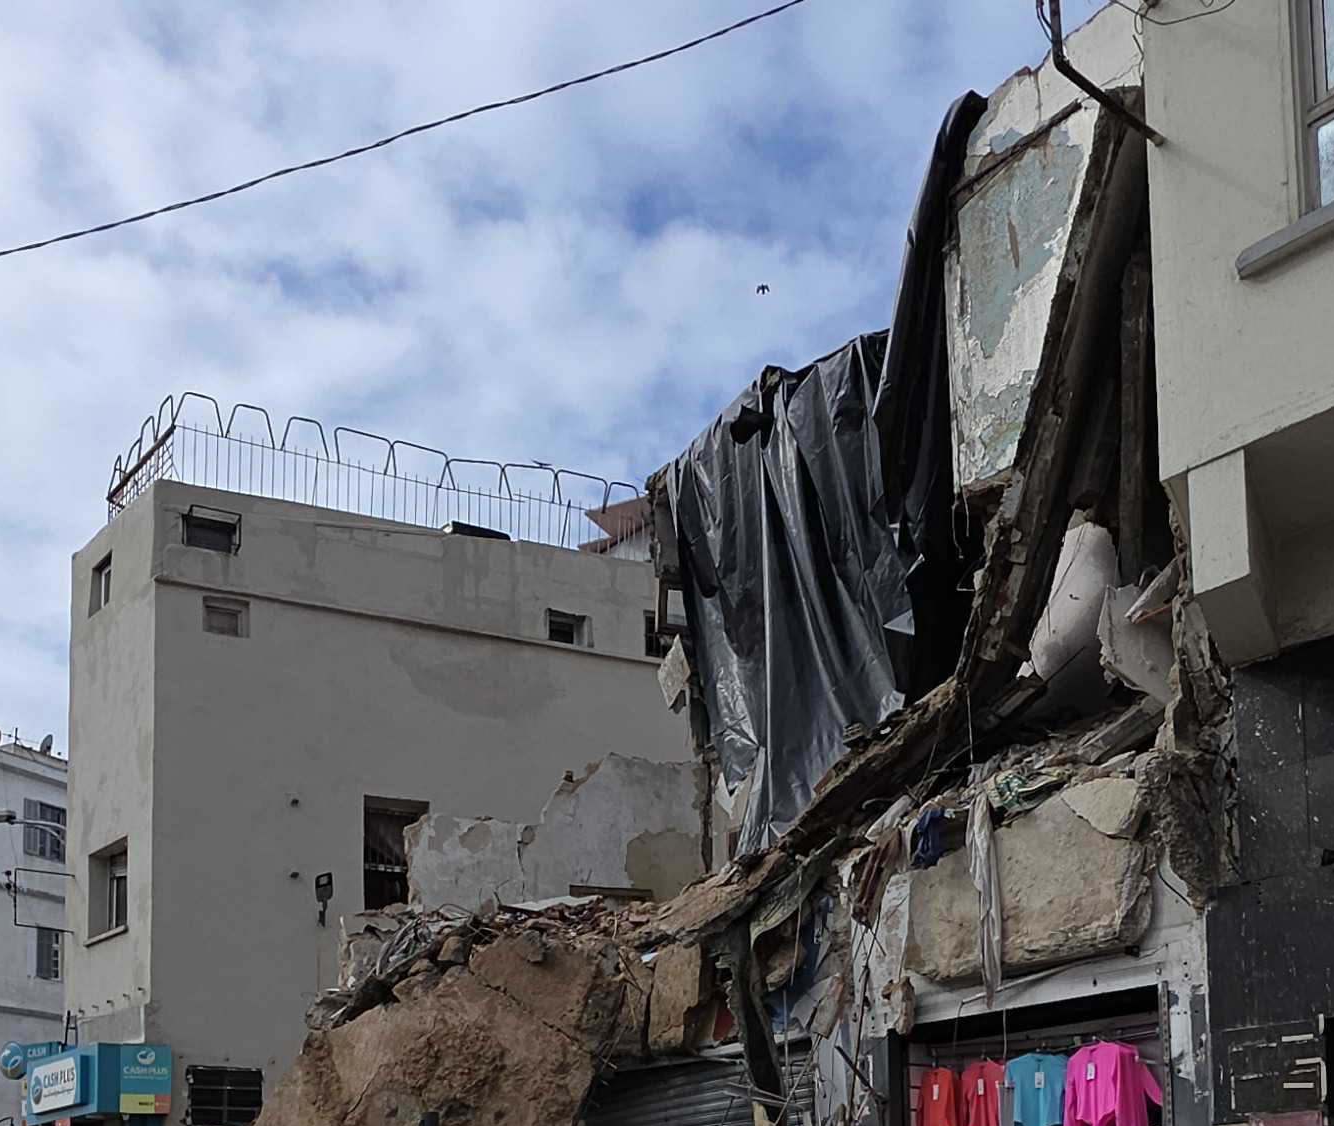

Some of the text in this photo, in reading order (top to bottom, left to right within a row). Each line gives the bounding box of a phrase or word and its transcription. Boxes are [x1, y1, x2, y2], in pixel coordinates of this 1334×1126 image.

[27, 1047, 47, 1058] CASH
[43, 1067, 75, 1088] CASH PLUS
